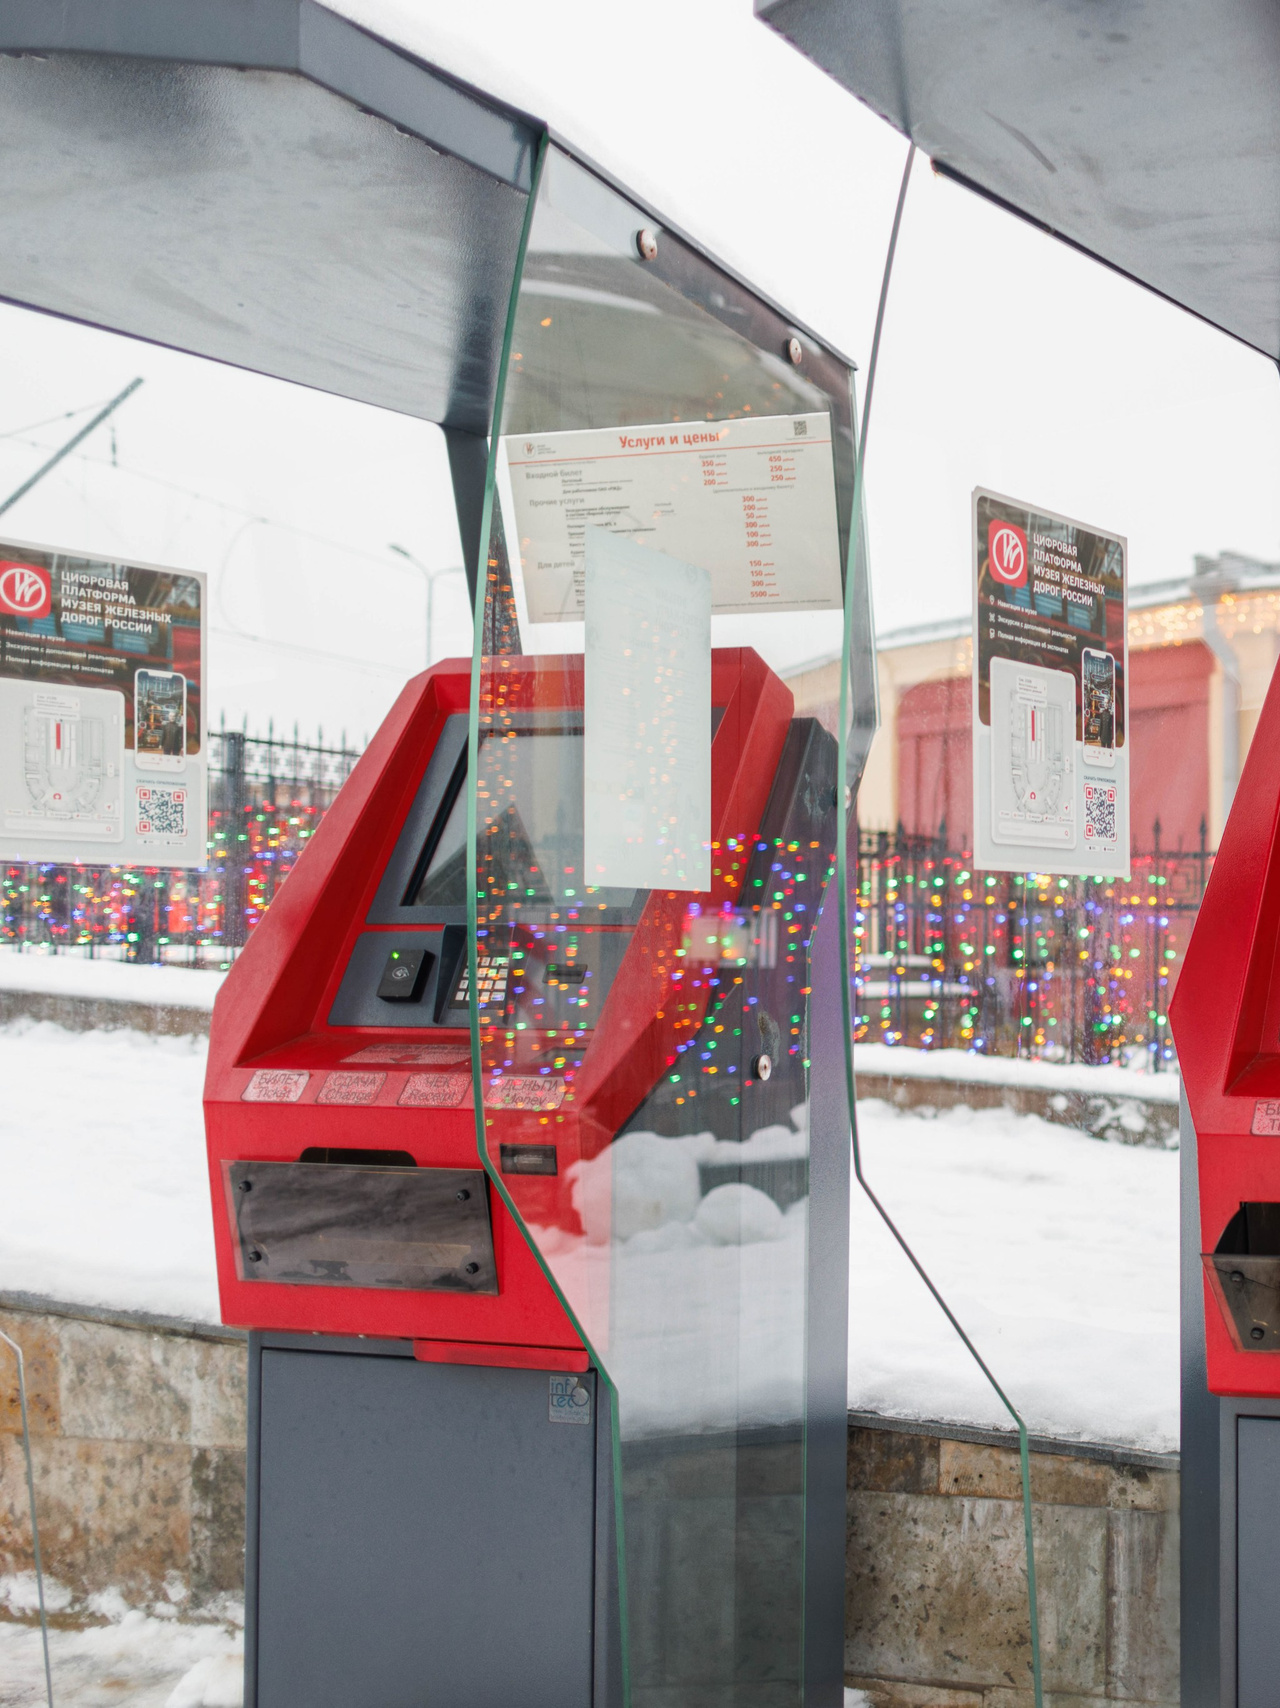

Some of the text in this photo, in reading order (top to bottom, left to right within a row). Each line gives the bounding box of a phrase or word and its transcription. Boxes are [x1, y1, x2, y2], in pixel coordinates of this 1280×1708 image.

[619, 432, 720, 450] Услуги и цены
[526, 470, 582, 480] Входной билет
[529, 497, 585, 507] Прочие услуги
[1034, 533, 1078, 557] ЦИФРОВАЯ
[554, 561, 575, 569] детей
[1034, 549, 1082, 574] ПЛАТФОРМА
[61, 571, 129, 591] ЦИФРОВАЯ
[1034, 565, 1105, 596] МУЗЕЯ ЖЕЛЕЗНЫХ
[61, 585, 136, 605] ПЛАТФОРМА
[1033, 580, 1093, 607] ДОРОГ РОССИИ
[61, 598, 172, 623] МУЗЕЯ ЖЕЛЕЗНЫХ
[997, 600, 1020, 611] Навигация
[61, 611, 152, 634] ДОРОГ РОССИИ
[998, 615, 1020, 627] Экскурсии
[5, 628, 40, 639] Навигация
[5, 641, 40, 652] Экскурсии
[998, 631, 1014, 640] Полная
[1014, 634, 1041, 647] информация
[1047, 644, 1069, 654] экспонатах
[5, 655, 30, 664] Полная
[31, 659, 71, 669] информация
[258, 1073, 304, 1085] БИЛЕТ
[333, 1076, 377, 1087] СДАЧА
[425, 1076, 450, 1088] ЧЕК
[502, 1079, 558, 1092] ДЕНЬГИ
[258, 1087, 292, 1098] Ticket
[326, 1089, 372, 1102] Change
[410, 1089, 456, 1101] Receipt
[507, 1094, 547, 1106] Money
